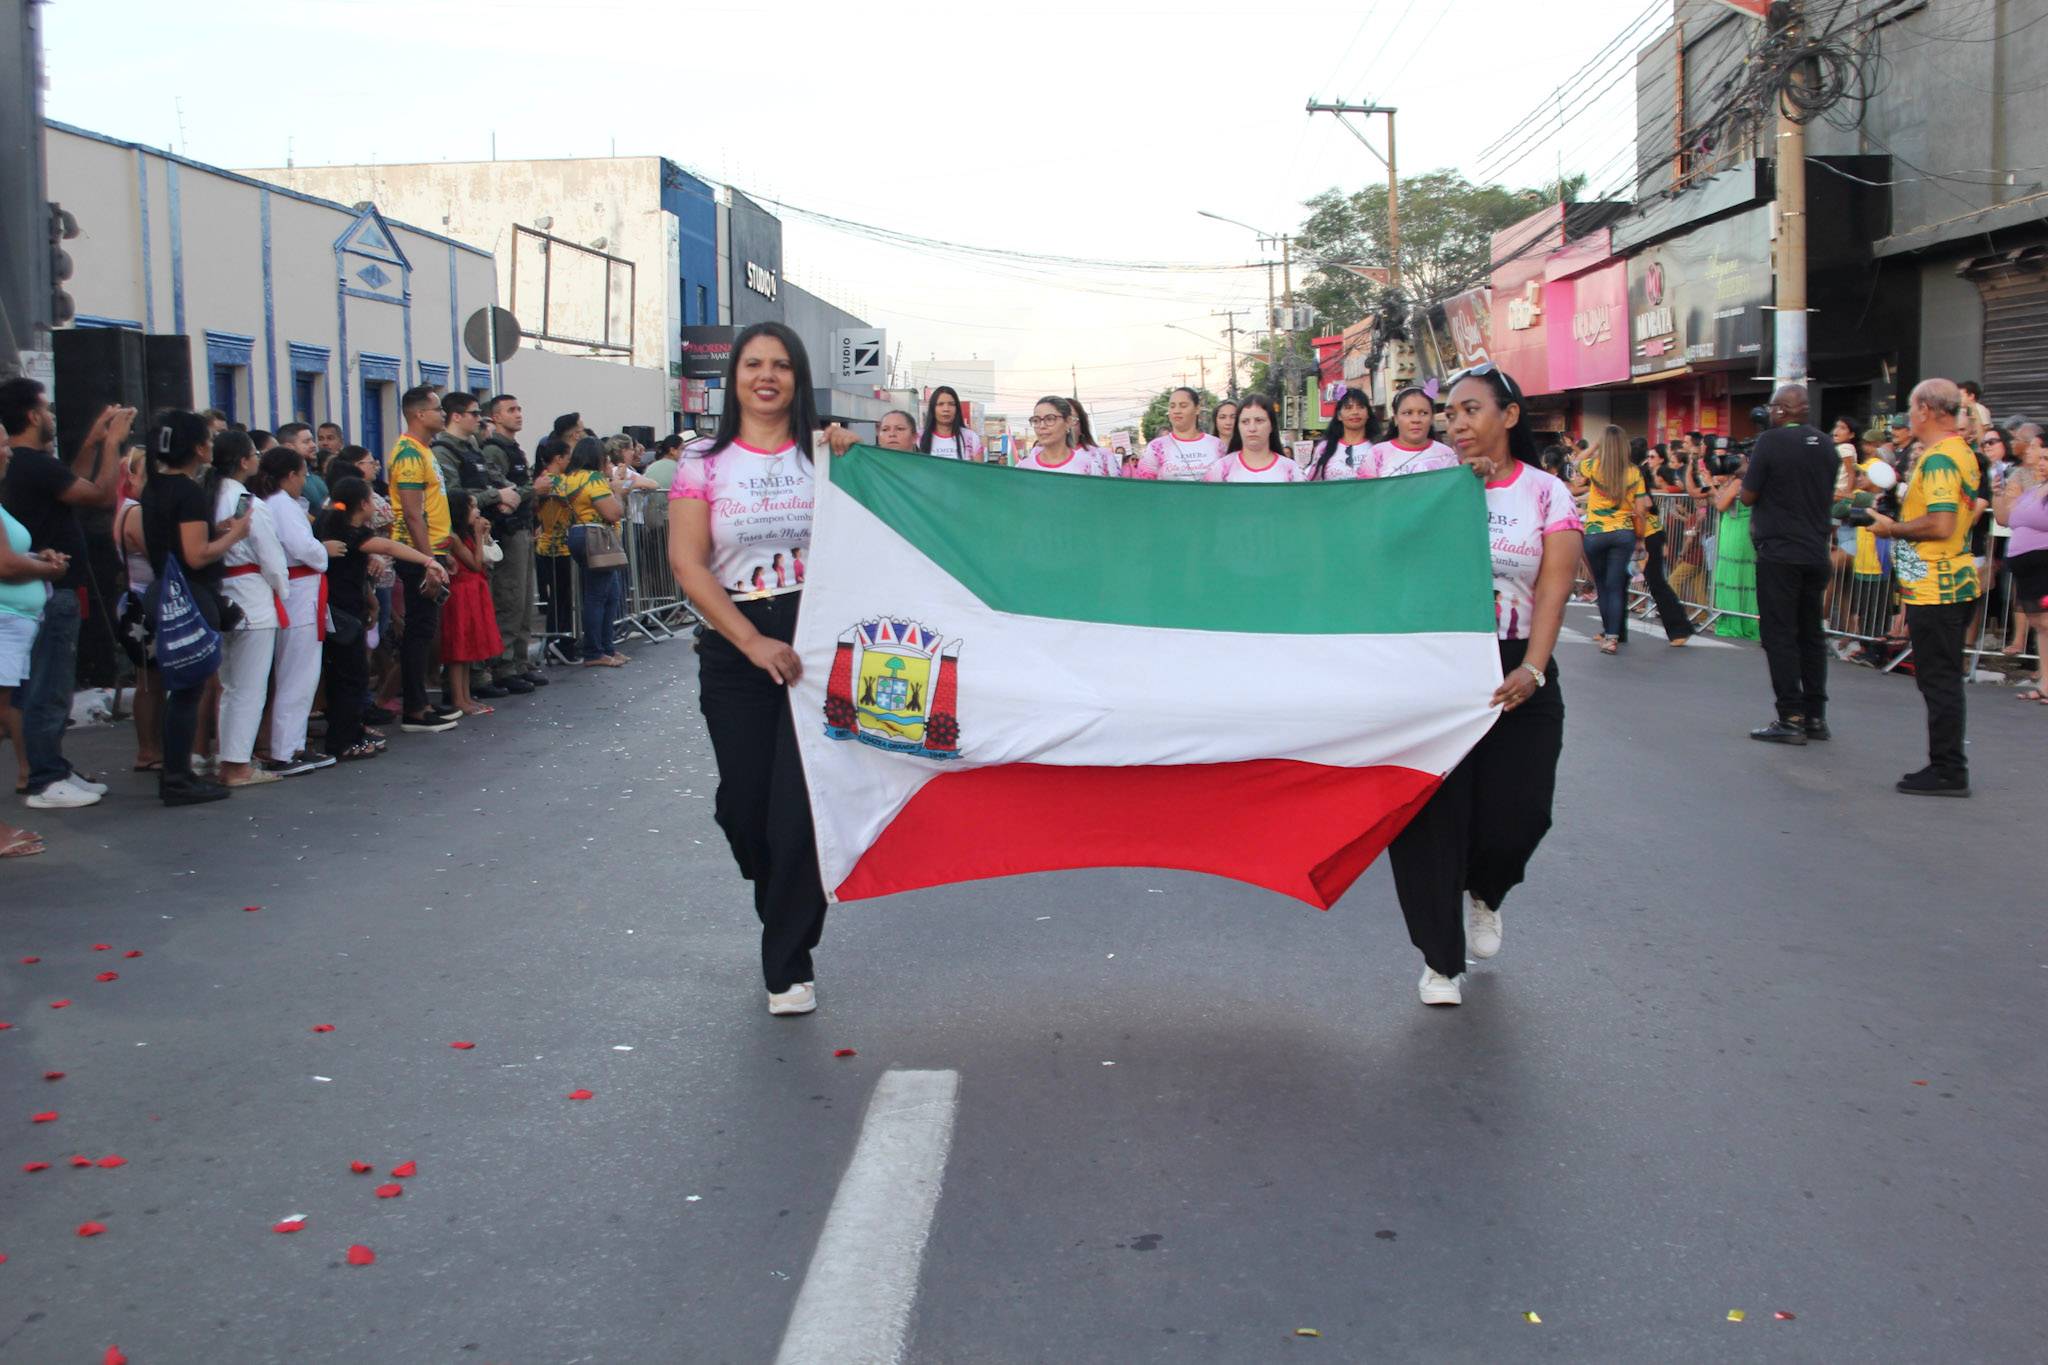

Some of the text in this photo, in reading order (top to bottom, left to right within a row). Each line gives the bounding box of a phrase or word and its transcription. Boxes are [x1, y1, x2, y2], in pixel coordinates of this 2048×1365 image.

[842, 337, 851, 377] STUDIO
[749, 475, 795, 489] EMEB
[711, 495, 815, 518] Rita Auxiliad
[734, 518, 745, 527] de
[746, 514, 785, 525] Campos
[1488, 511, 1508, 526] EB
[1492, 536, 1541, 557] iliadora
